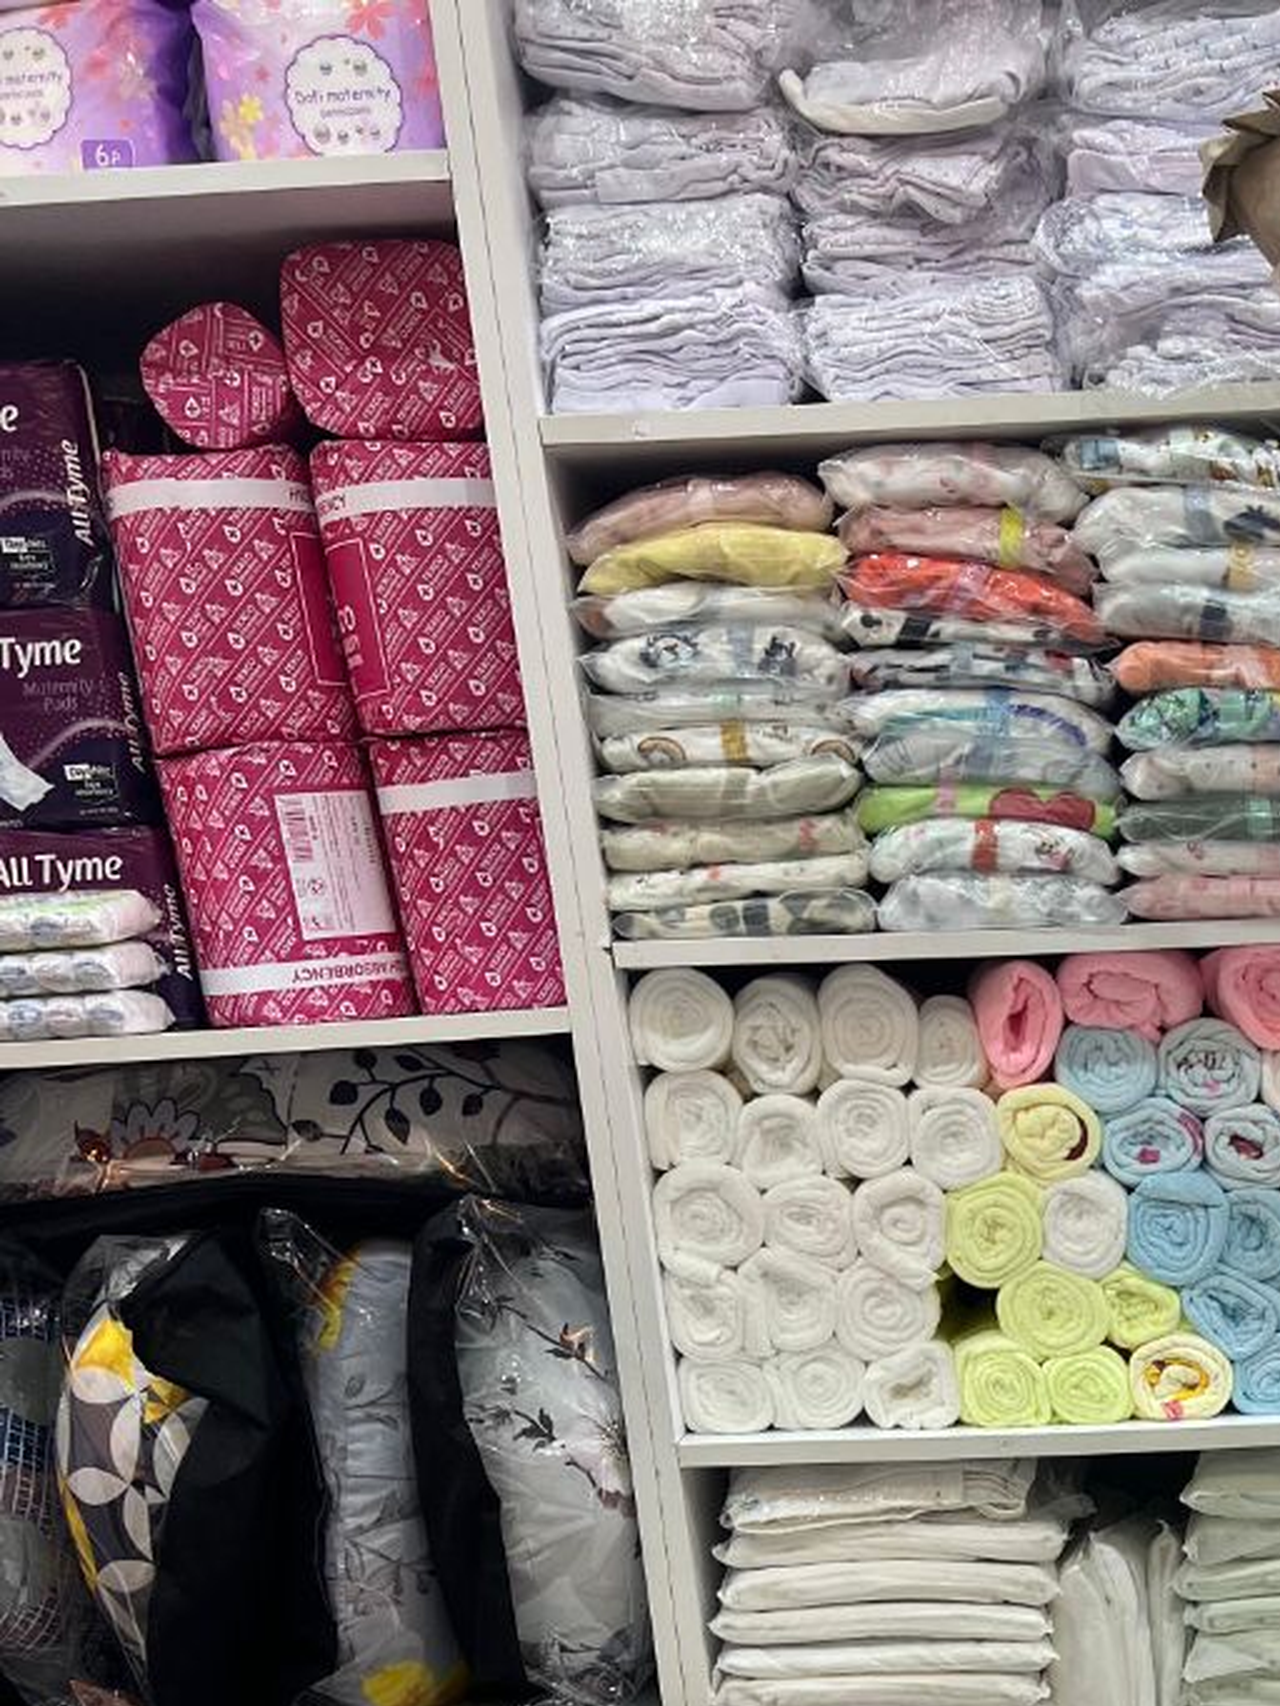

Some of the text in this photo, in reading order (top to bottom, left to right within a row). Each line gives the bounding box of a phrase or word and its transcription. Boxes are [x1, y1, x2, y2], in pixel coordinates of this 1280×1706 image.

[60, 438, 95, 546] All Tyme
[0, 636, 82, 678] Tyme
[34, 853, 124, 893] Tyme
[163, 884, 188, 946] Tyme
